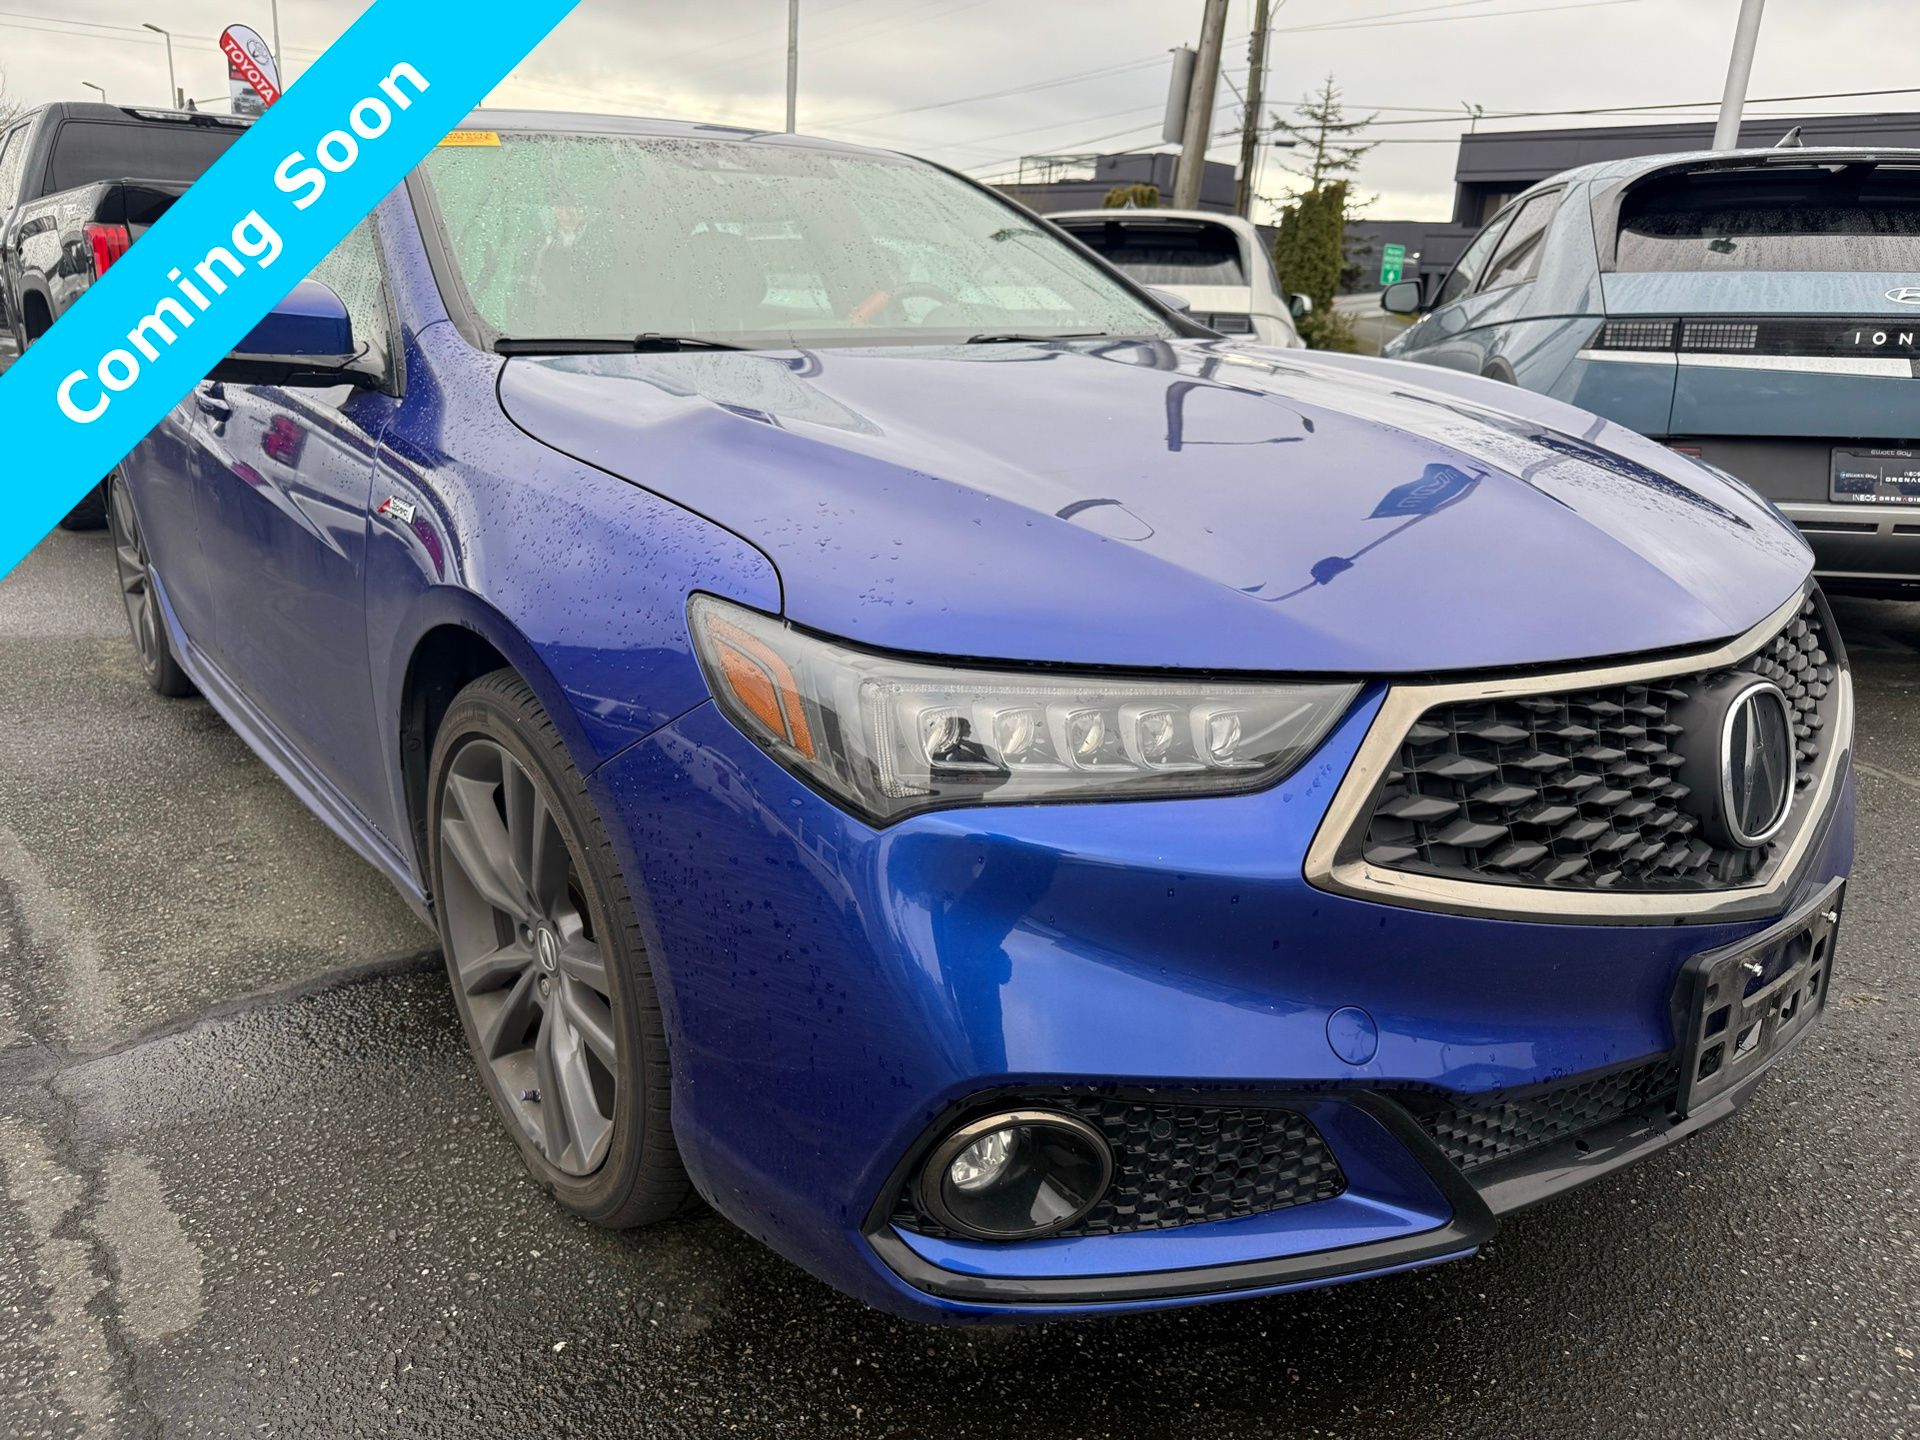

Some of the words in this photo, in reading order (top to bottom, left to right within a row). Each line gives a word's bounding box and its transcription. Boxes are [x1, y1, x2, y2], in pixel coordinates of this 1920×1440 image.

[224, 40, 274, 102] TOYOTA
[1854, 331, 1914, 346] ION
[1852, 493, 1877, 502] INEOS
